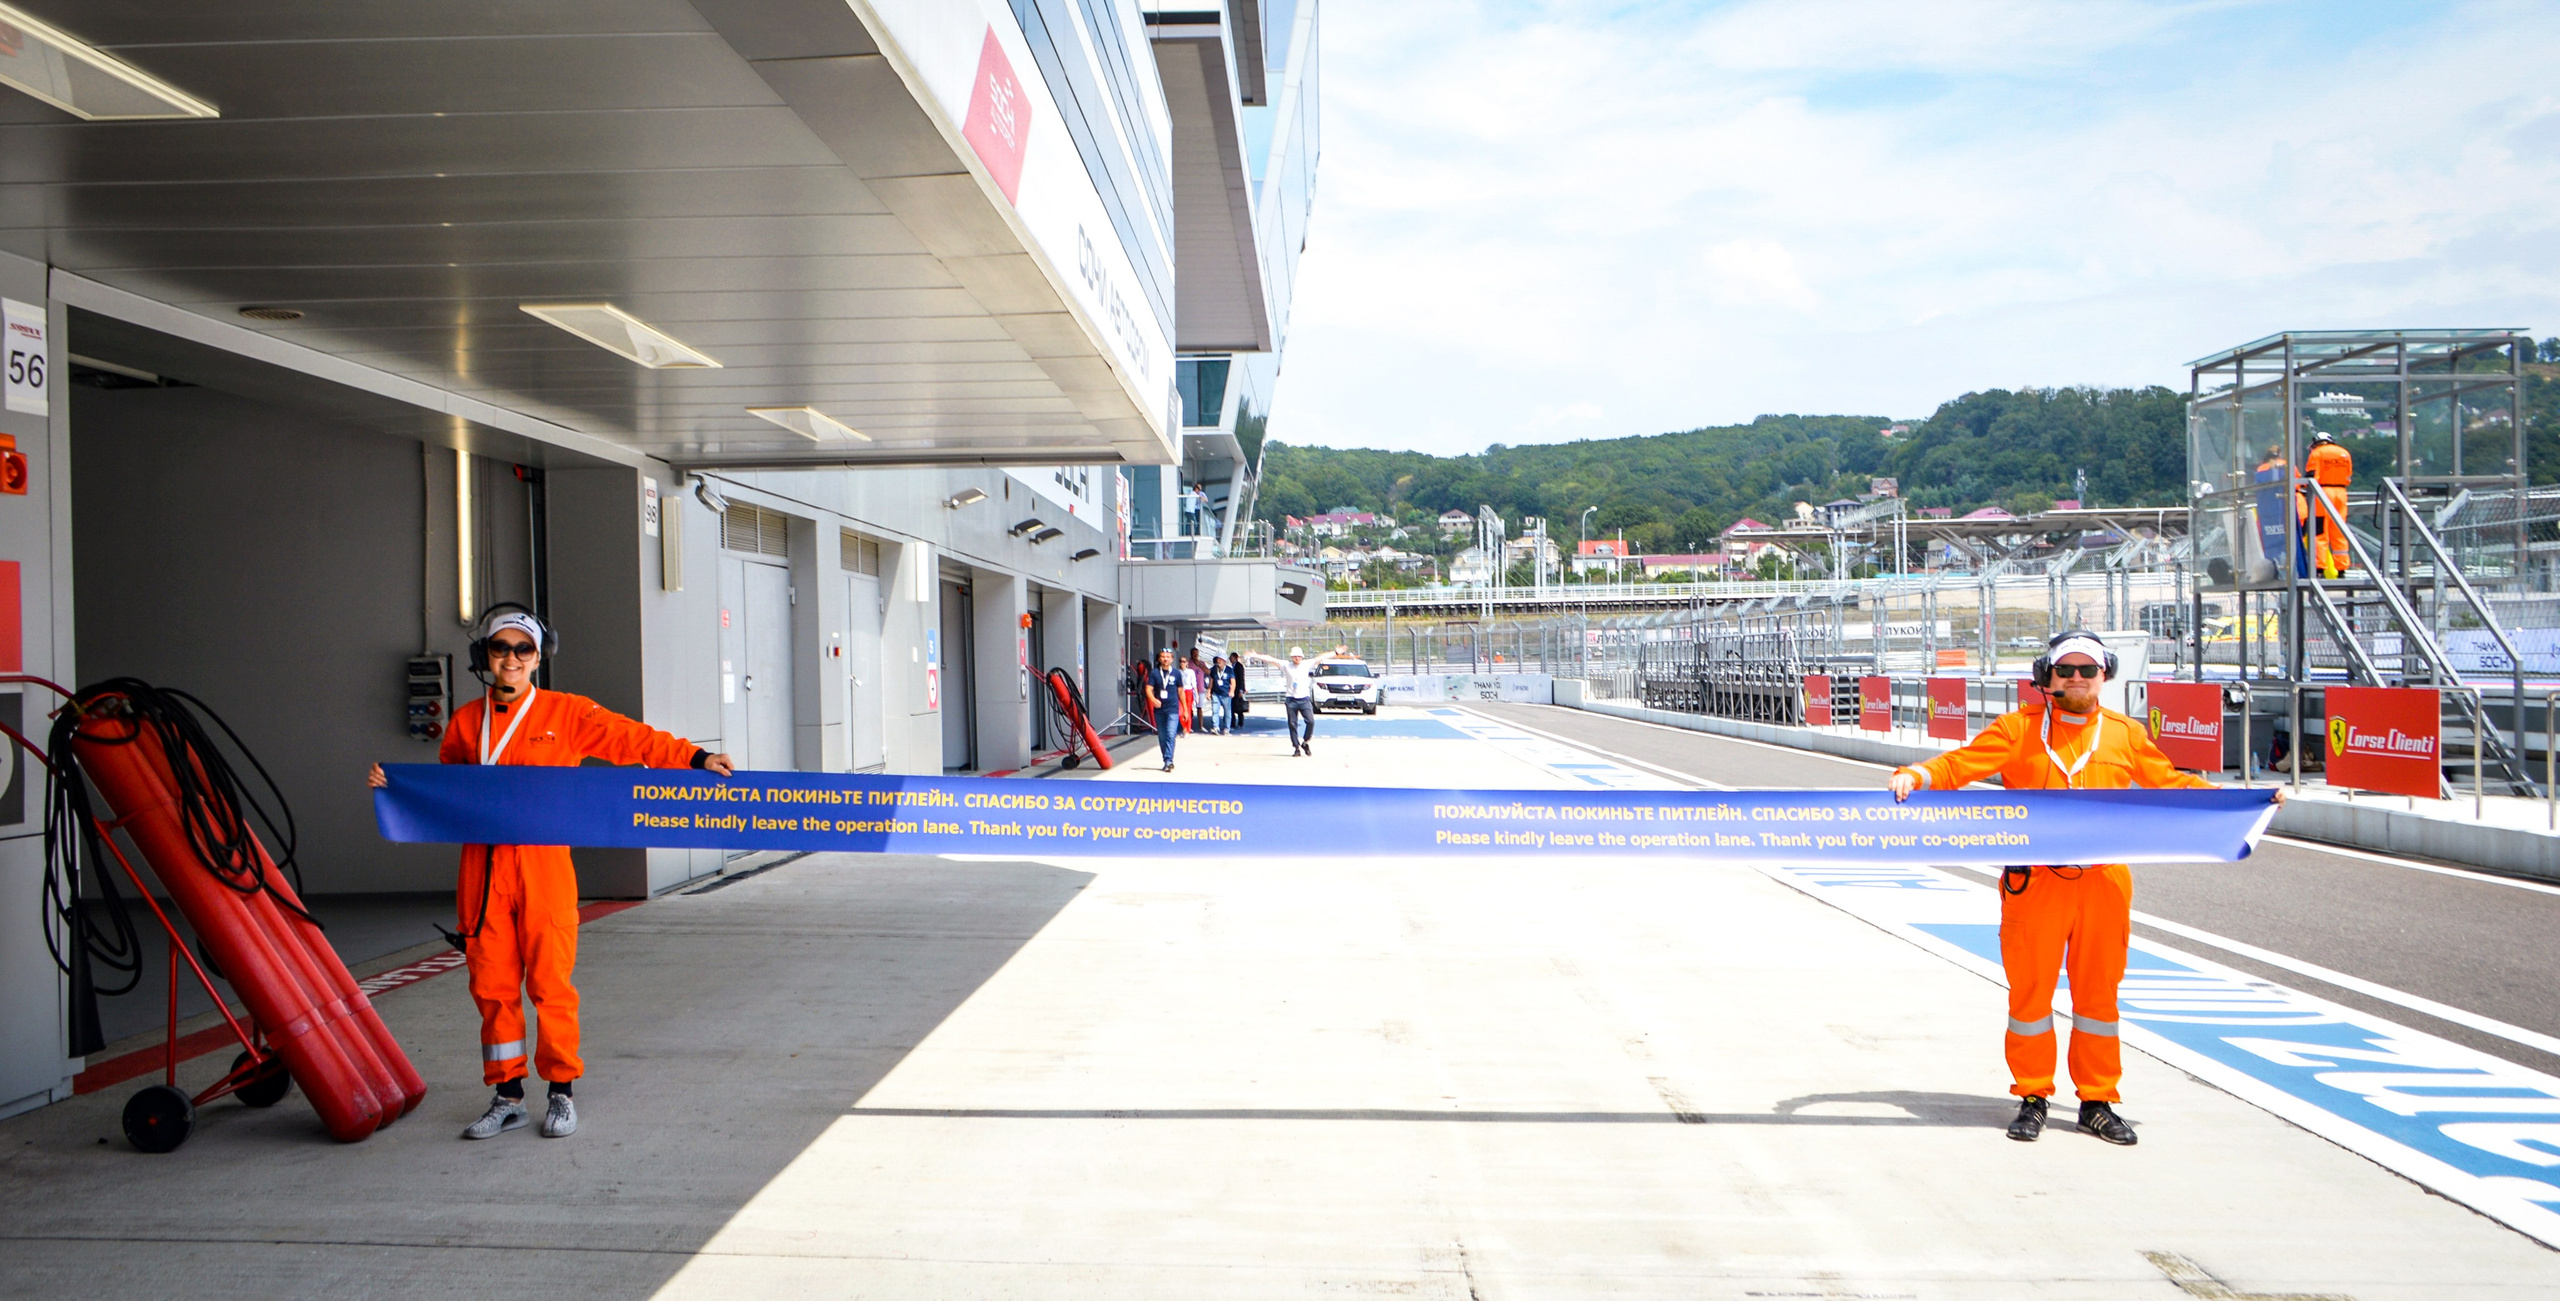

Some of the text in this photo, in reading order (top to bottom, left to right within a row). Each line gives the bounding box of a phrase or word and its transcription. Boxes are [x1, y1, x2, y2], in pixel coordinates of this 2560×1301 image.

[1079, 223, 1108, 315] СОЧИ
[9, 350, 45, 388] 56
[1934, 701, 1966, 717] Corse Clienti
[2161, 714, 2219, 737] Corse Clienti
[2347, 725, 2436, 754] Corse Clienti
[633, 783, 1244, 815] ПОЖАЛУЙСТА ПОКИНЬТЕ ПИТЛЕЙН. СПАСИБО ЗА СОТРУДНИЧЕСТВО
[1434, 802, 2029, 823] ПОЖАЛУЙСТА ПОКИНЬТЕ ПИТЛЕЙН. СПАСИБО ЗА СОТРУДНИЧЕСТВО
[633, 813, 1242, 843] Please kindly leave the operation lane. Thank you for your co-operation
[1436, 831, 2030, 849] Please kindly leave the operation lane. Thank you for your co-operation
